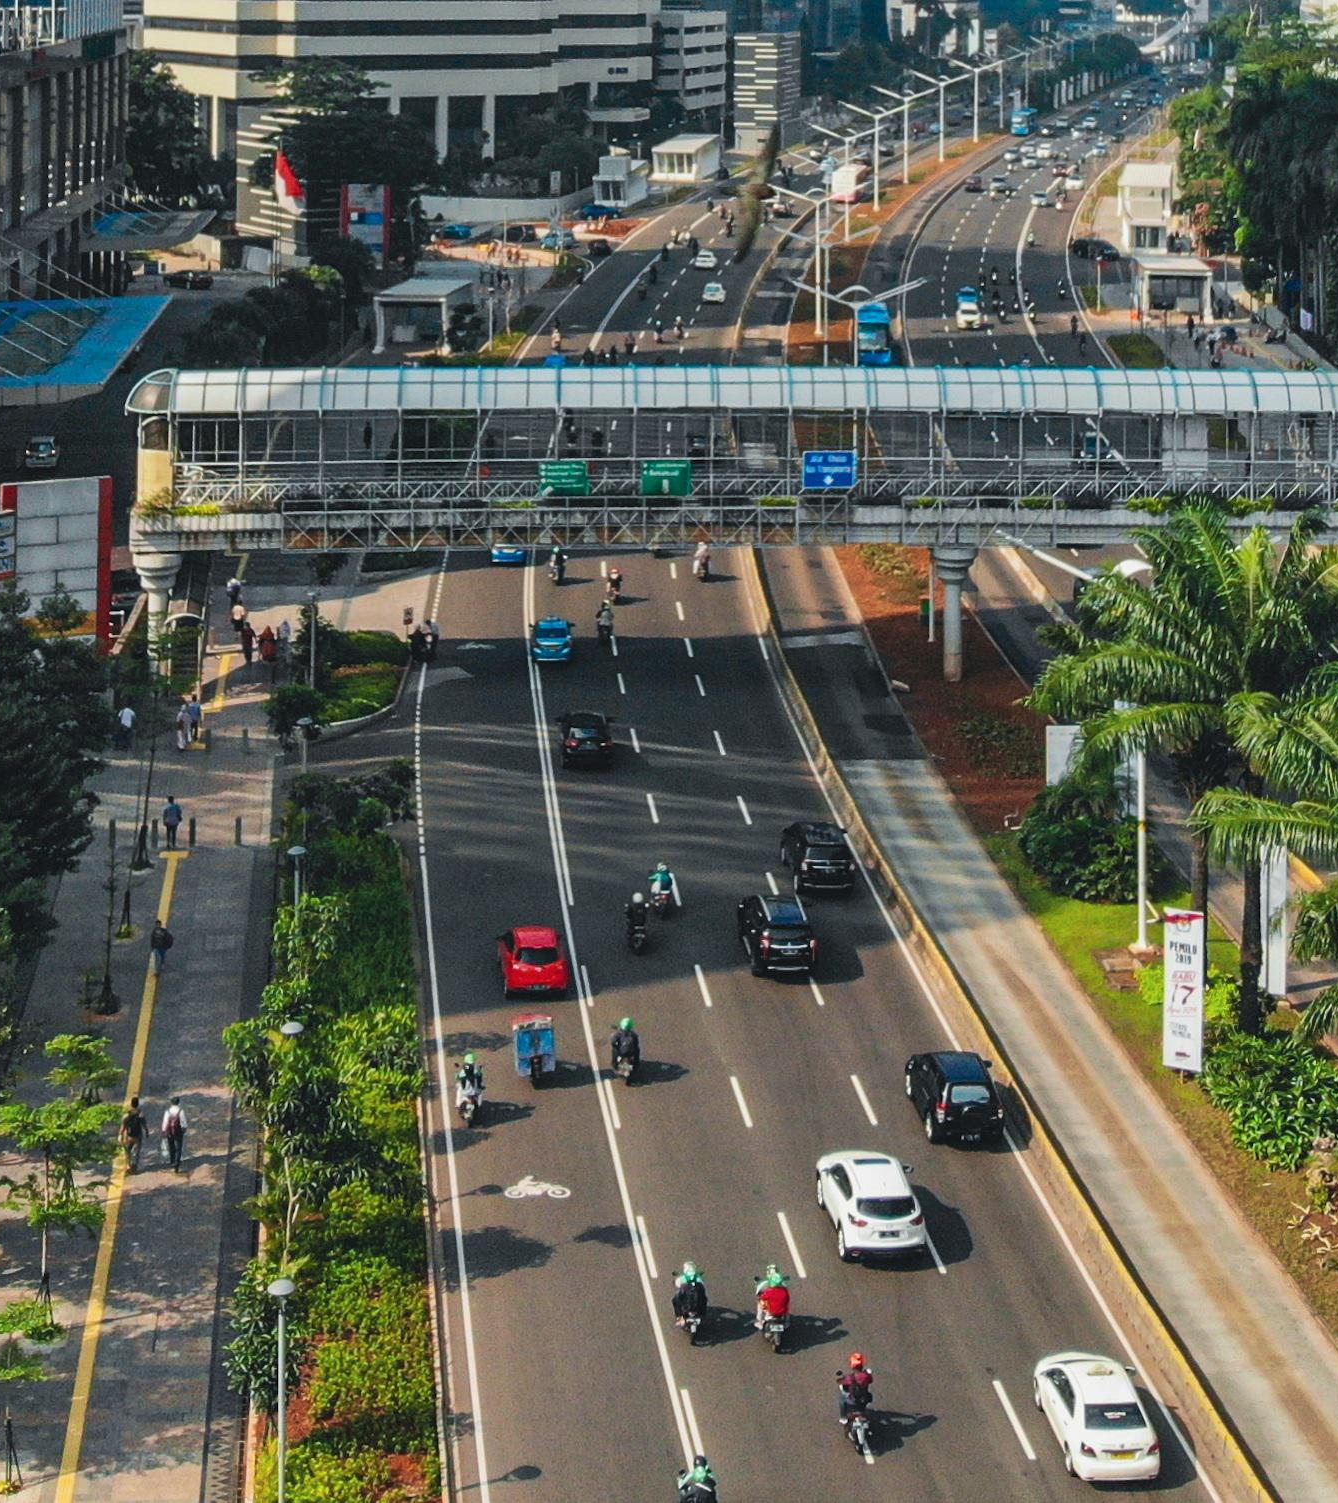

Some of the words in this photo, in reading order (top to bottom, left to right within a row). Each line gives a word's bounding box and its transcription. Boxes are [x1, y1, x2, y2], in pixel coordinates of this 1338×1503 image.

[1169, 941, 1197, 955] PEMILU
[1175, 953, 1191, 965] 2019
[1171, 984, 1195, 1005] 17
